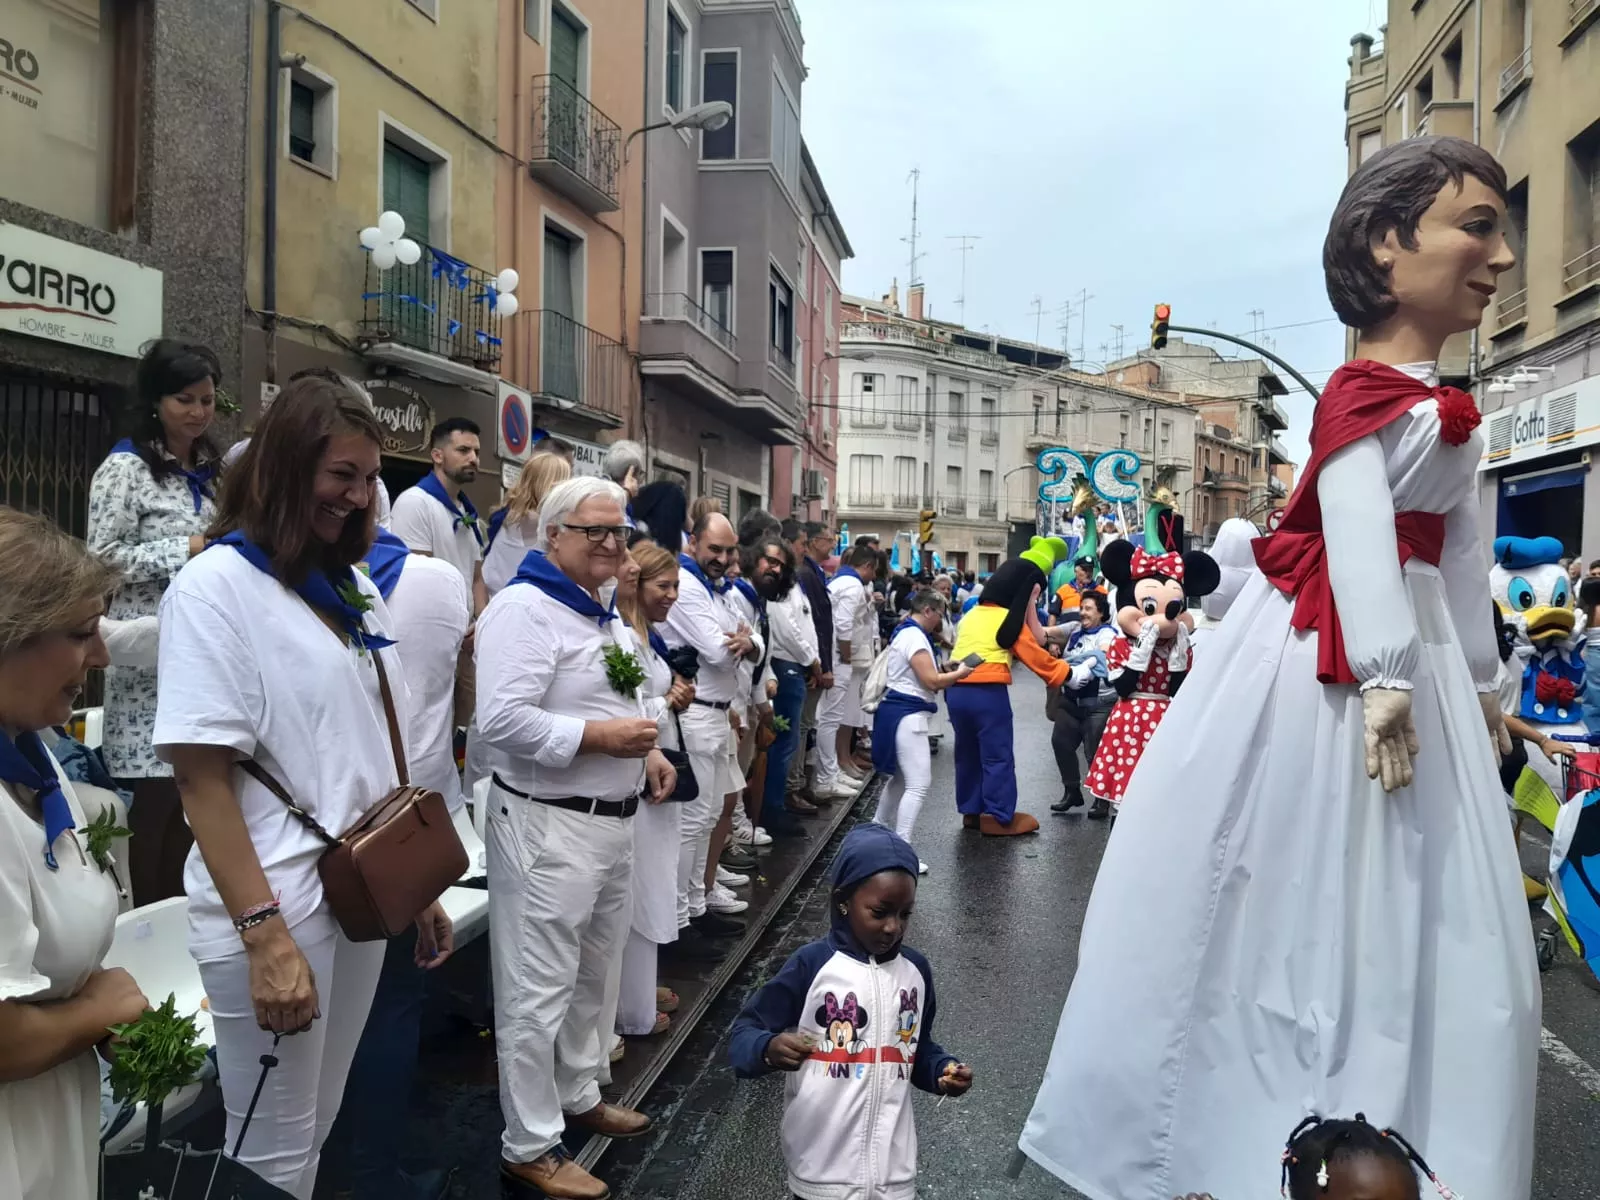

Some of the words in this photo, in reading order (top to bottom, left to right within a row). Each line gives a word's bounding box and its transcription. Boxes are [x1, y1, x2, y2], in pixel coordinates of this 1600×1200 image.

[19, 317, 66, 339] HOMBRE
[82, 331, 115, 350] MUJER
[1514, 409, 1544, 444] Gotta
